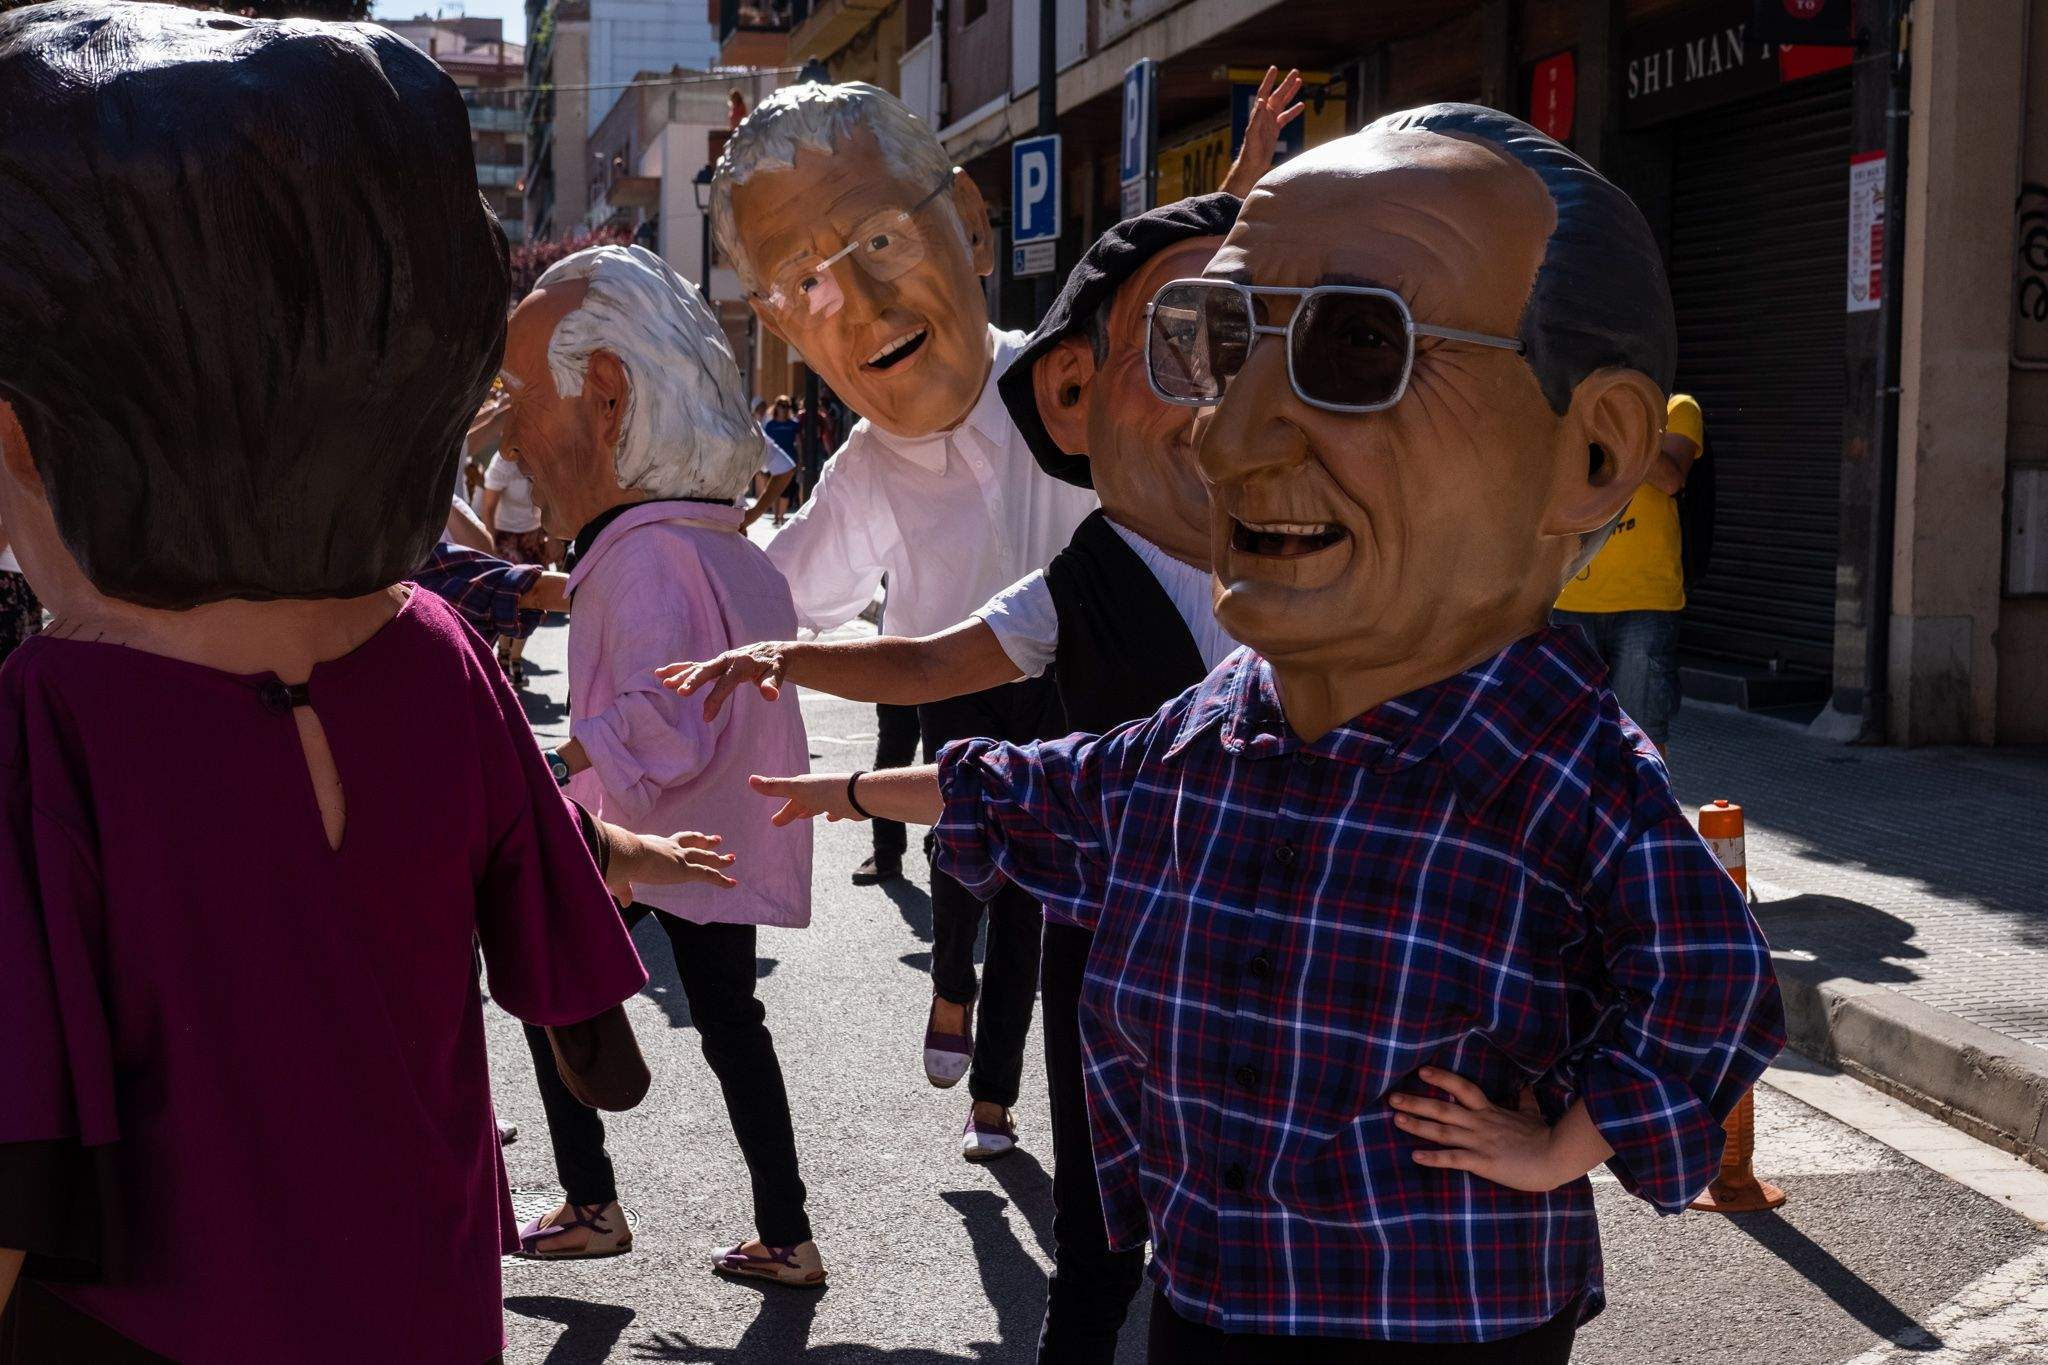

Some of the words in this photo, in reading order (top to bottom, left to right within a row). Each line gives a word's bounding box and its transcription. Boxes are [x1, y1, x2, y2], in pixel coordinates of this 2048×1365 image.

[1627, 48, 1674, 99] SHI
[1683, 24, 1746, 82] MAN
[1125, 80, 1139, 170] P
[1021, 151, 1048, 230] P
